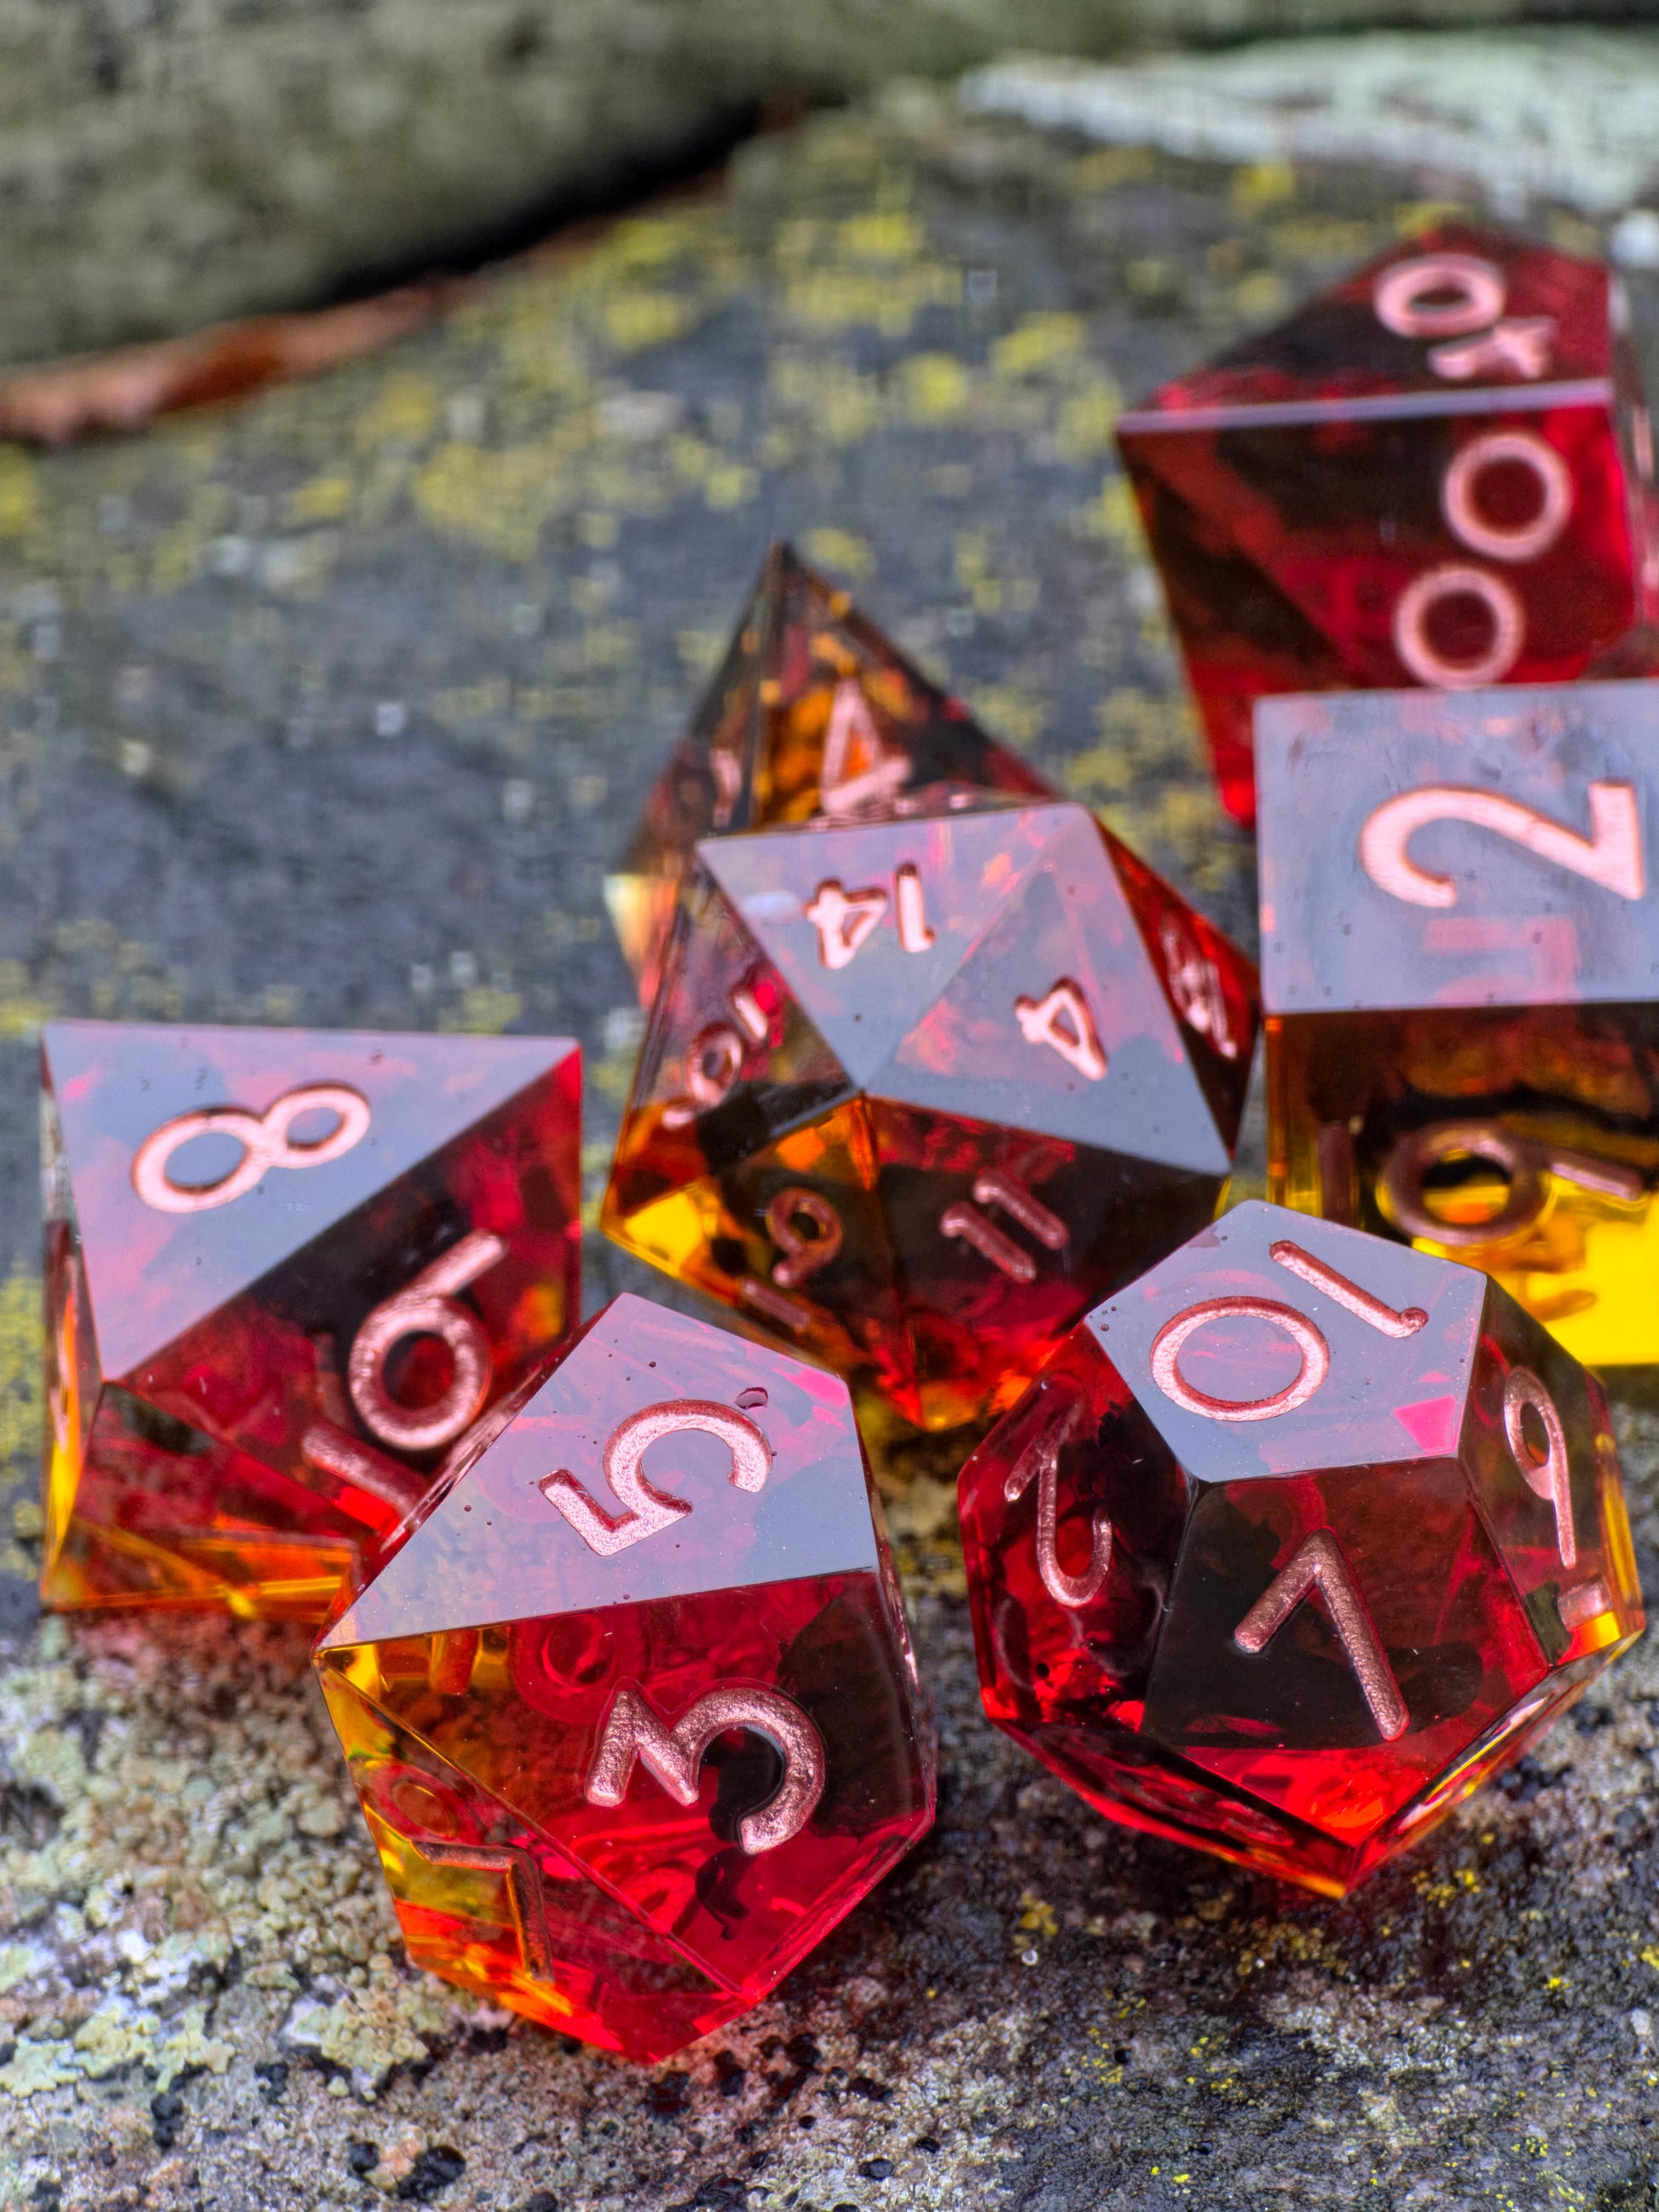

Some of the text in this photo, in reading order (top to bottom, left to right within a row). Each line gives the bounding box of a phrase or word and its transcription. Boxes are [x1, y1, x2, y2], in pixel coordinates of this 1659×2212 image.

[1393, 433, 1574, 690] 00
[806, 863, 936, 970] 14
[1357, 781, 1647, 910] 2
[1014, 978, 1110, 1083] 4
[130, 1083, 373, 1216] 8
[940, 1170, 1071, 1285] 11
[350, 1227, 506, 1451] 6
[1150, 1239, 1429, 1423] 10
[537, 1399, 774, 1556] 5
[1504, 1366, 1577, 1571] 9
[1233, 1527, 1411, 1742] 7
[583, 1679, 825, 1857] 3
